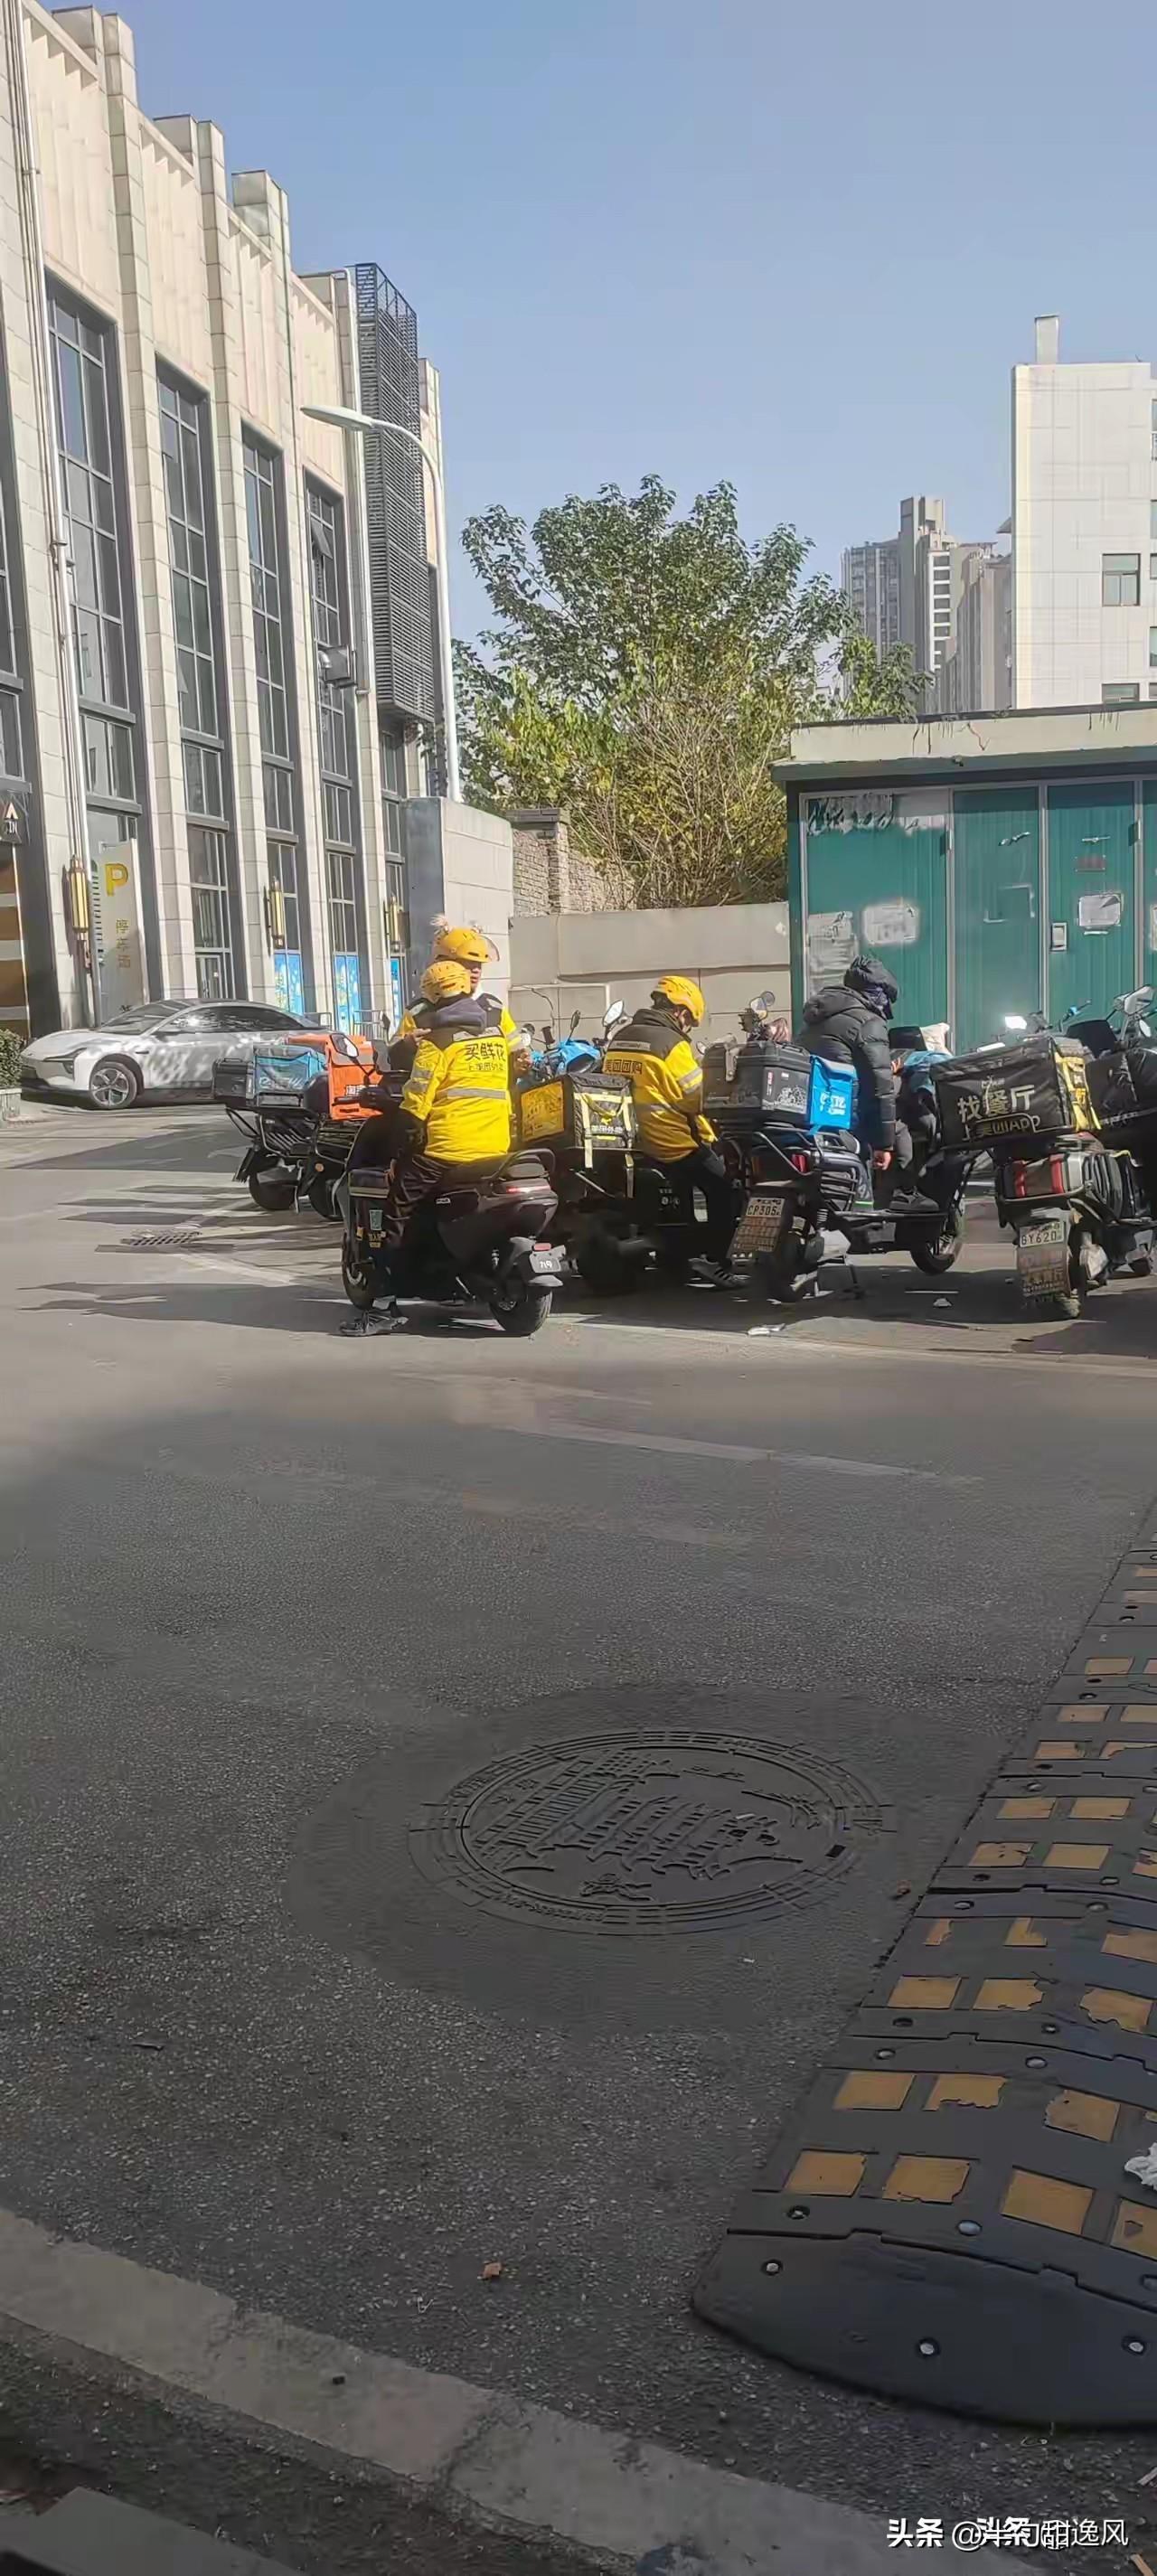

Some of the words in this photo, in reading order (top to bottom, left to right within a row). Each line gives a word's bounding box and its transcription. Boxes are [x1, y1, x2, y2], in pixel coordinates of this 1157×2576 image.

[104, 862, 129, 897] P
[464, 1042, 506, 1061] 买鲜花
